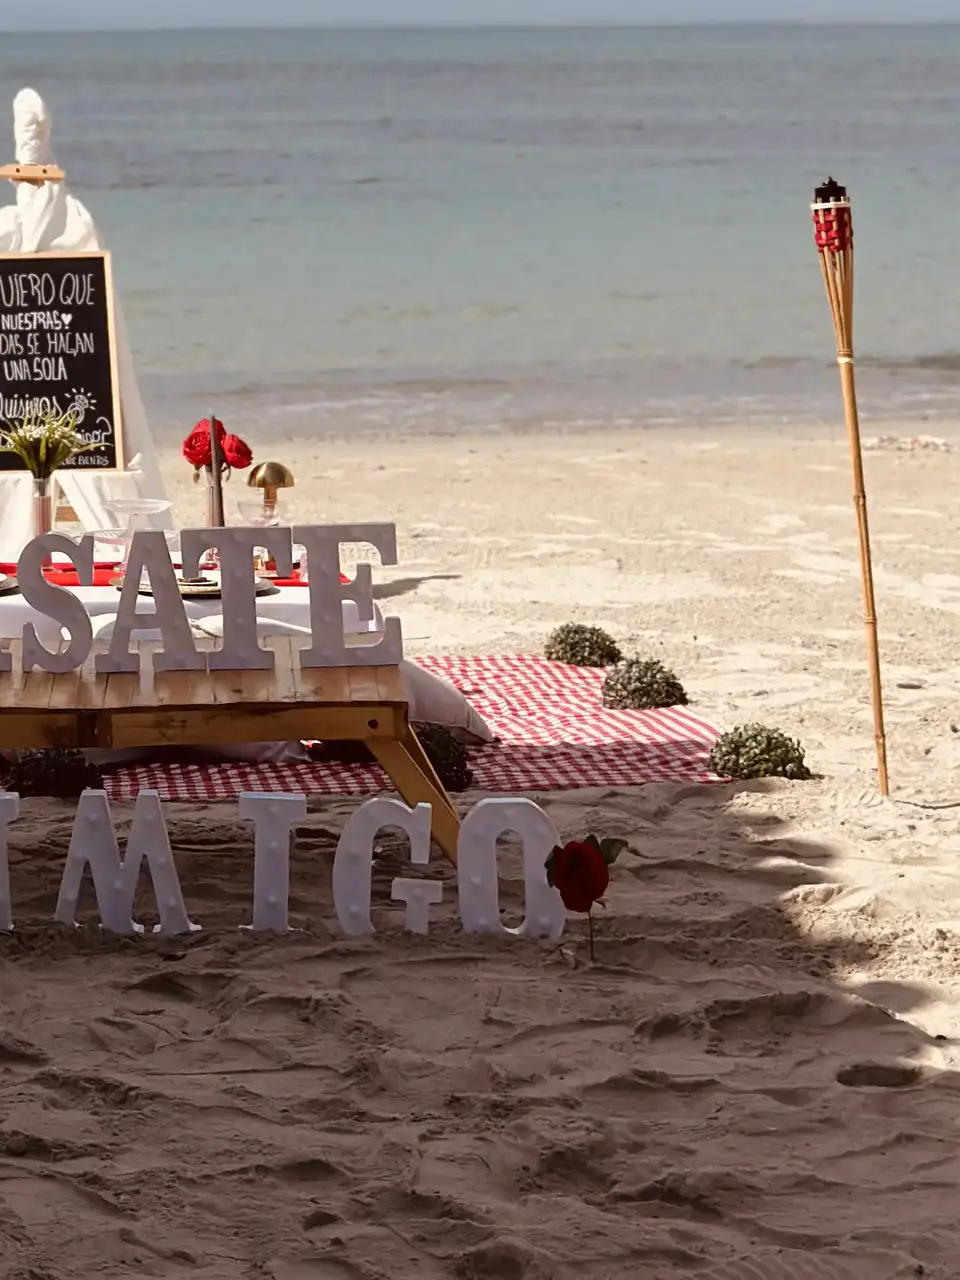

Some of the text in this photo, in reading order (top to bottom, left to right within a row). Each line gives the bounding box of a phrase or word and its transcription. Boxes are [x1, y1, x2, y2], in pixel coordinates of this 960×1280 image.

[59, 272, 95, 306] QUE
[1, 310, 62, 331] NUESTRAS
[27, 333, 41, 355] SE
[47, 332, 95, 357] HAGAN
[3, 356, 68, 381] UNA SOLA
